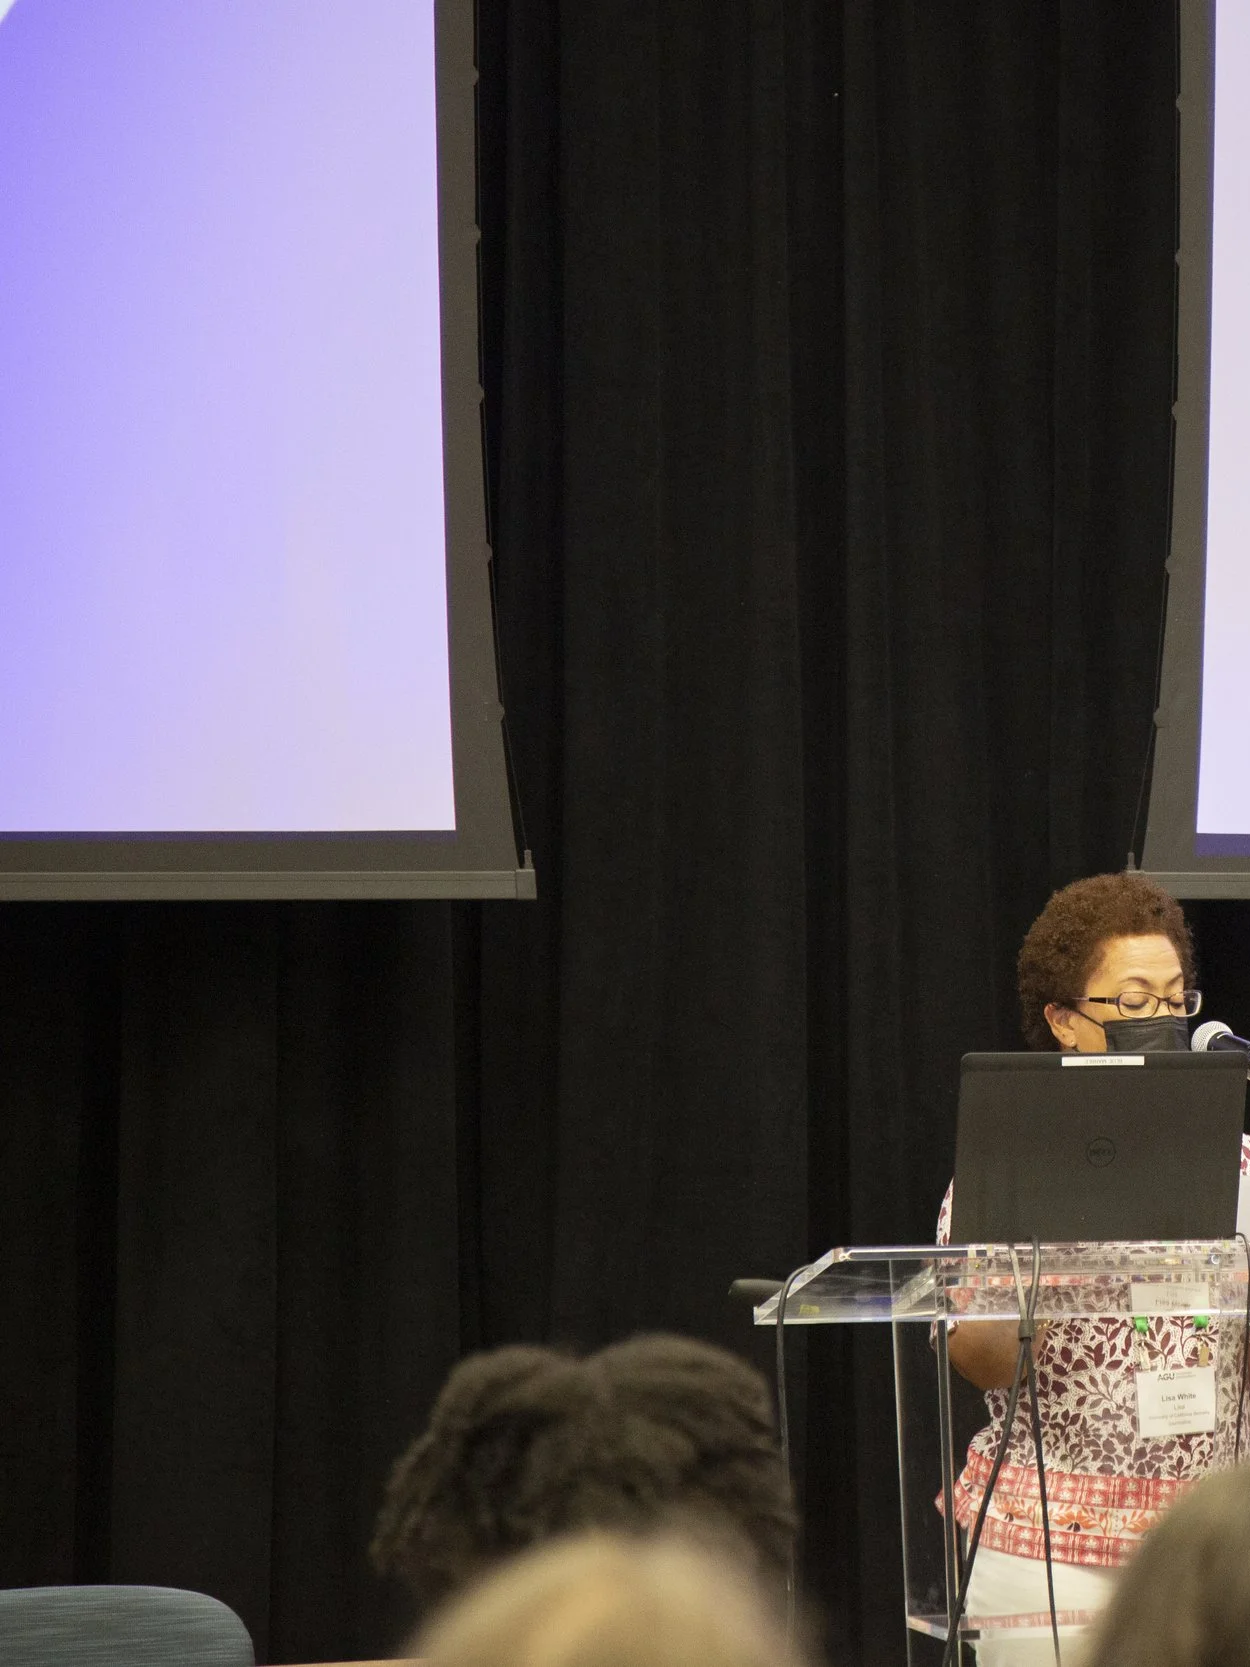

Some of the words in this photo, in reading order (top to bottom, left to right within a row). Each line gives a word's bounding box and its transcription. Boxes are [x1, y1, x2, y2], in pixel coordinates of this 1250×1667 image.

[1157, 1372, 1175, 1381] AGU
[1161, 1394, 1176, 1402] Lisa
[1177, 1392, 1197, 1401] White
